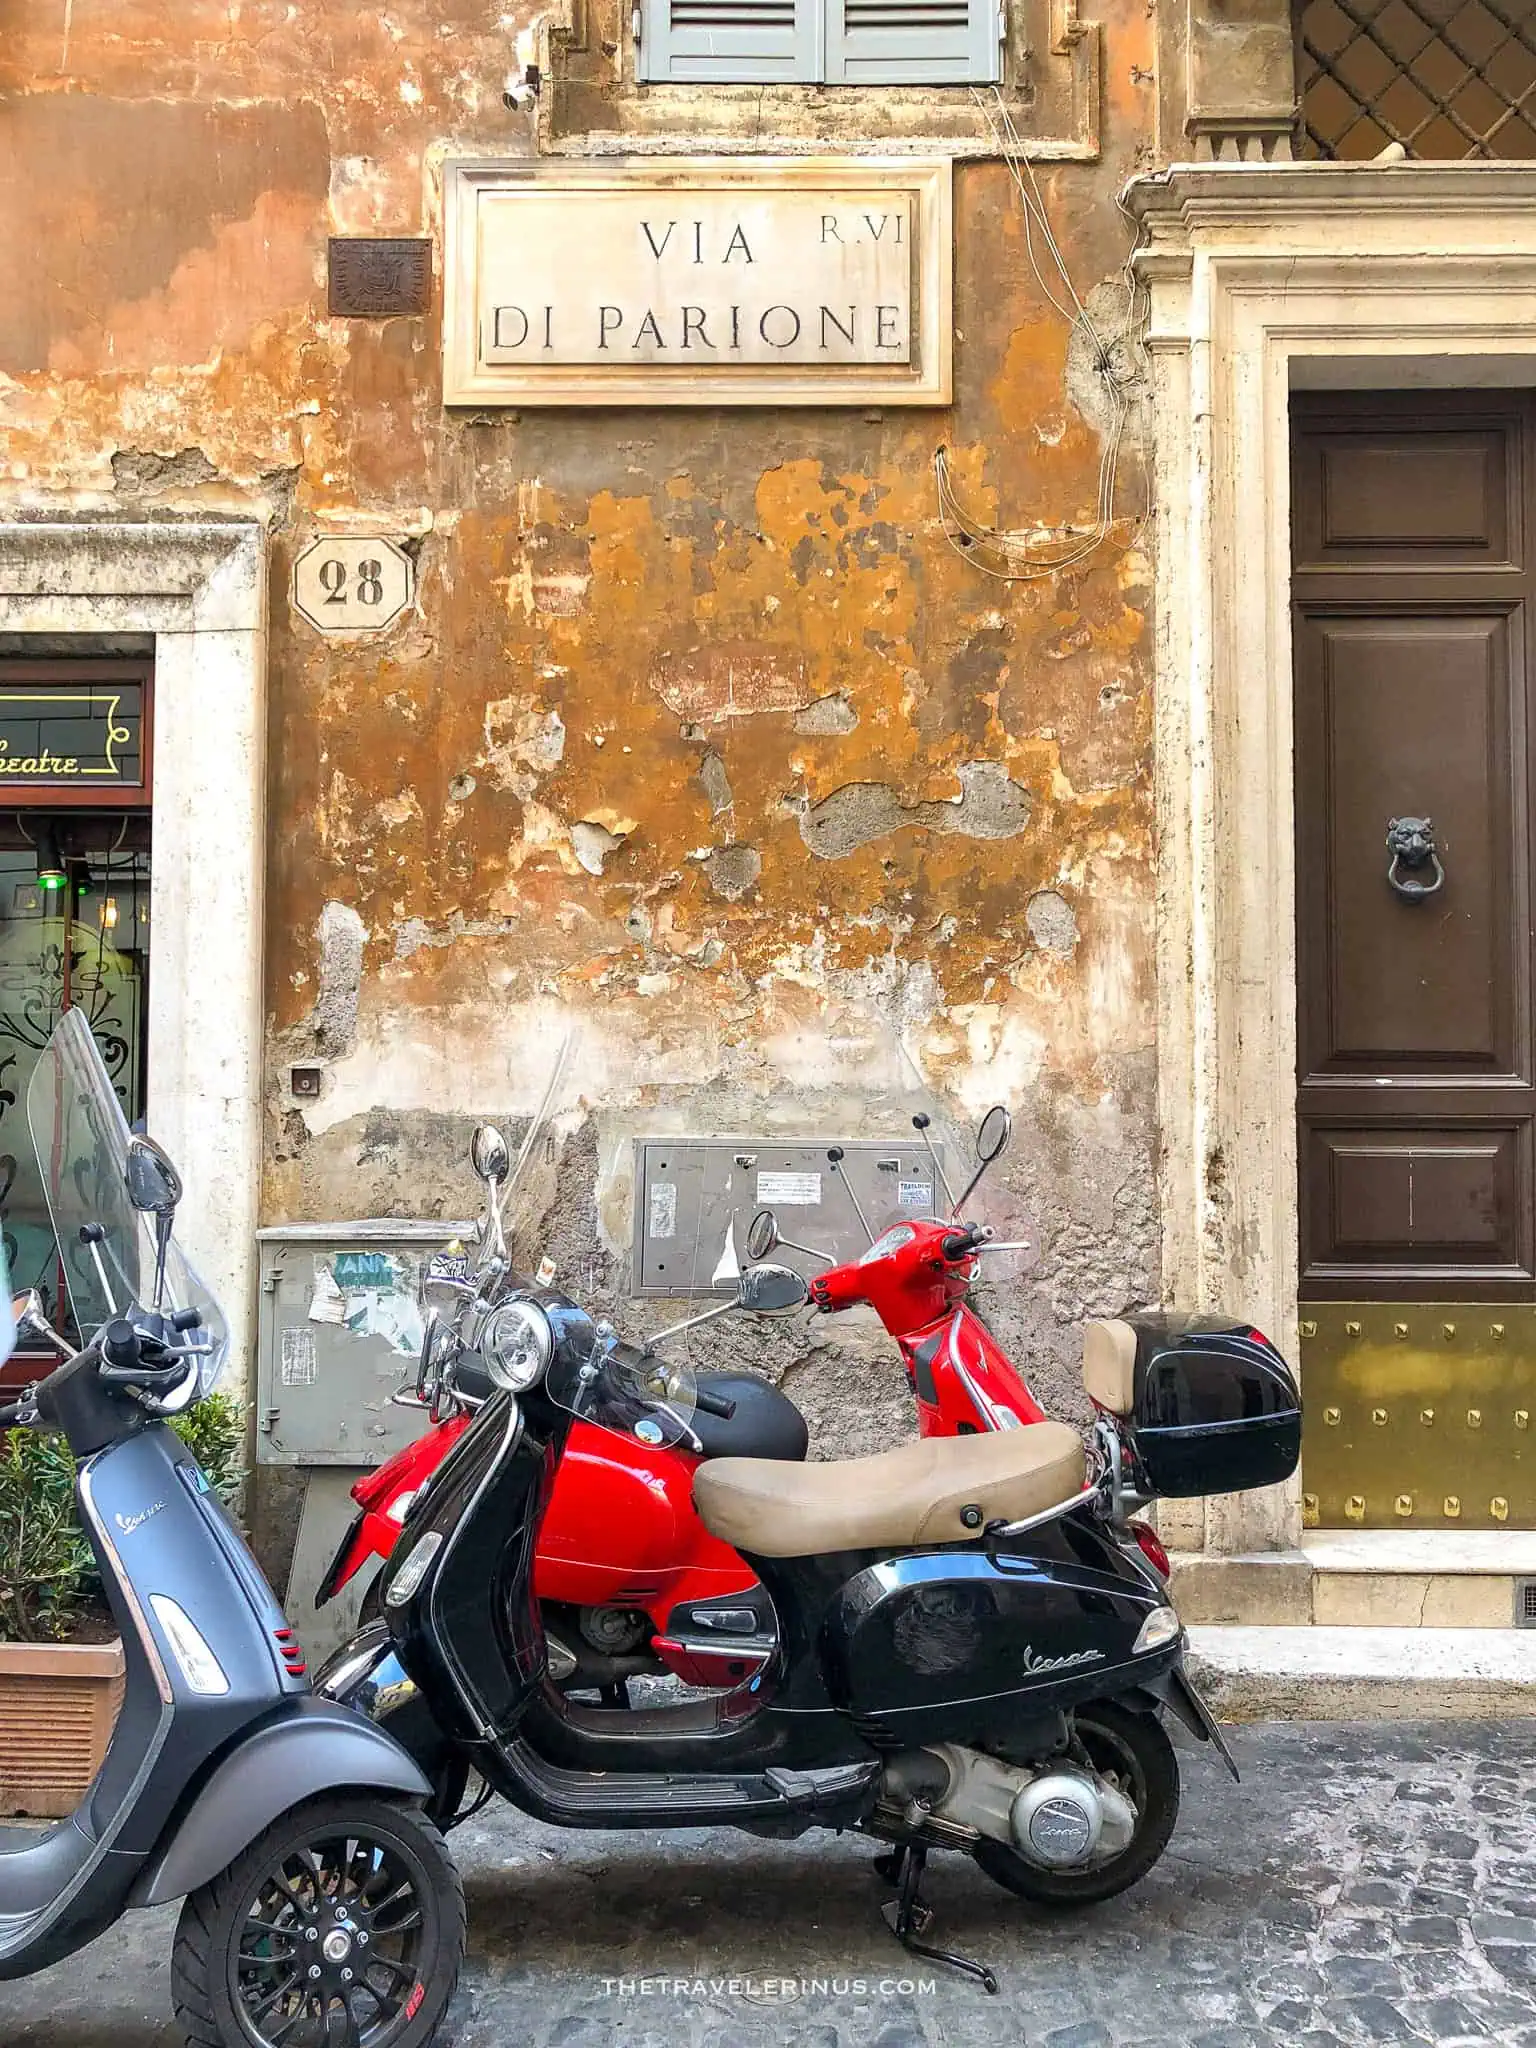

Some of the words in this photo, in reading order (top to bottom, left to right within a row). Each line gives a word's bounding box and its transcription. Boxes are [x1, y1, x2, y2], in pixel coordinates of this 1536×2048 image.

[639, 221, 758, 264] VIA
[492, 305, 553, 349] DI
[597, 305, 902, 349] PARIONE
[318, 558, 384, 606] 28
[1023, 1645, 1106, 1677] Vespa
